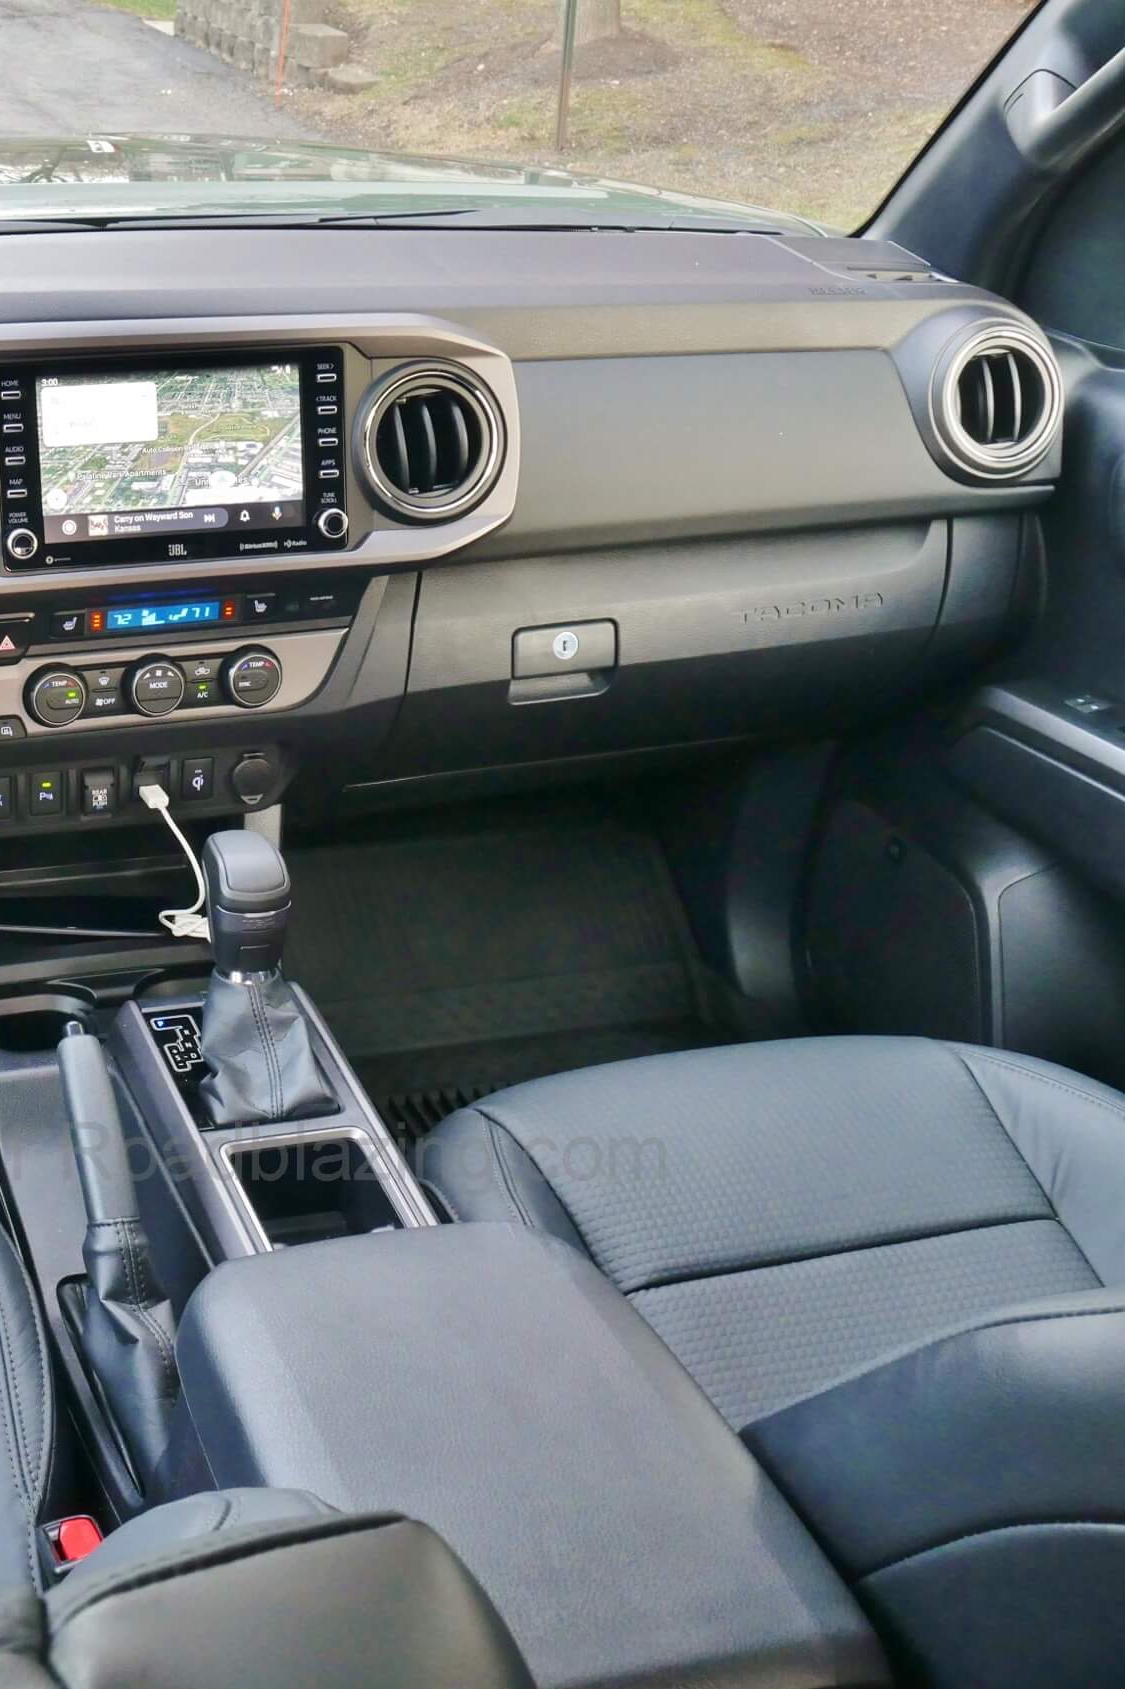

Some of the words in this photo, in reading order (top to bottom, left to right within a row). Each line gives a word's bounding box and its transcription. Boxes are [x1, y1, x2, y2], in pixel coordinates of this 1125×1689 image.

[1, 379, 20, 387] HOME
[41, 378, 59, 387] 3:00
[9, 478, 23, 486] MAP
[114, 515, 133, 525] Carry
[145, 512, 177, 524] Wayward
[179, 510, 193, 520] Son
[115, 524, 141, 533] Kansas
[169, 543, 188, 556] JBL
[191, 606, 210, 618] 71
[732, 592, 884, 624] TACOMA
[113, 614, 132, 625] 72
[249, 660, 265, 669] TEMP
[51, 680, 68, 688] TEMP
[149, 681, 168, 689] MODE
[197, 691, 208, 699] A/C
[104, 697, 116, 706] OFF
